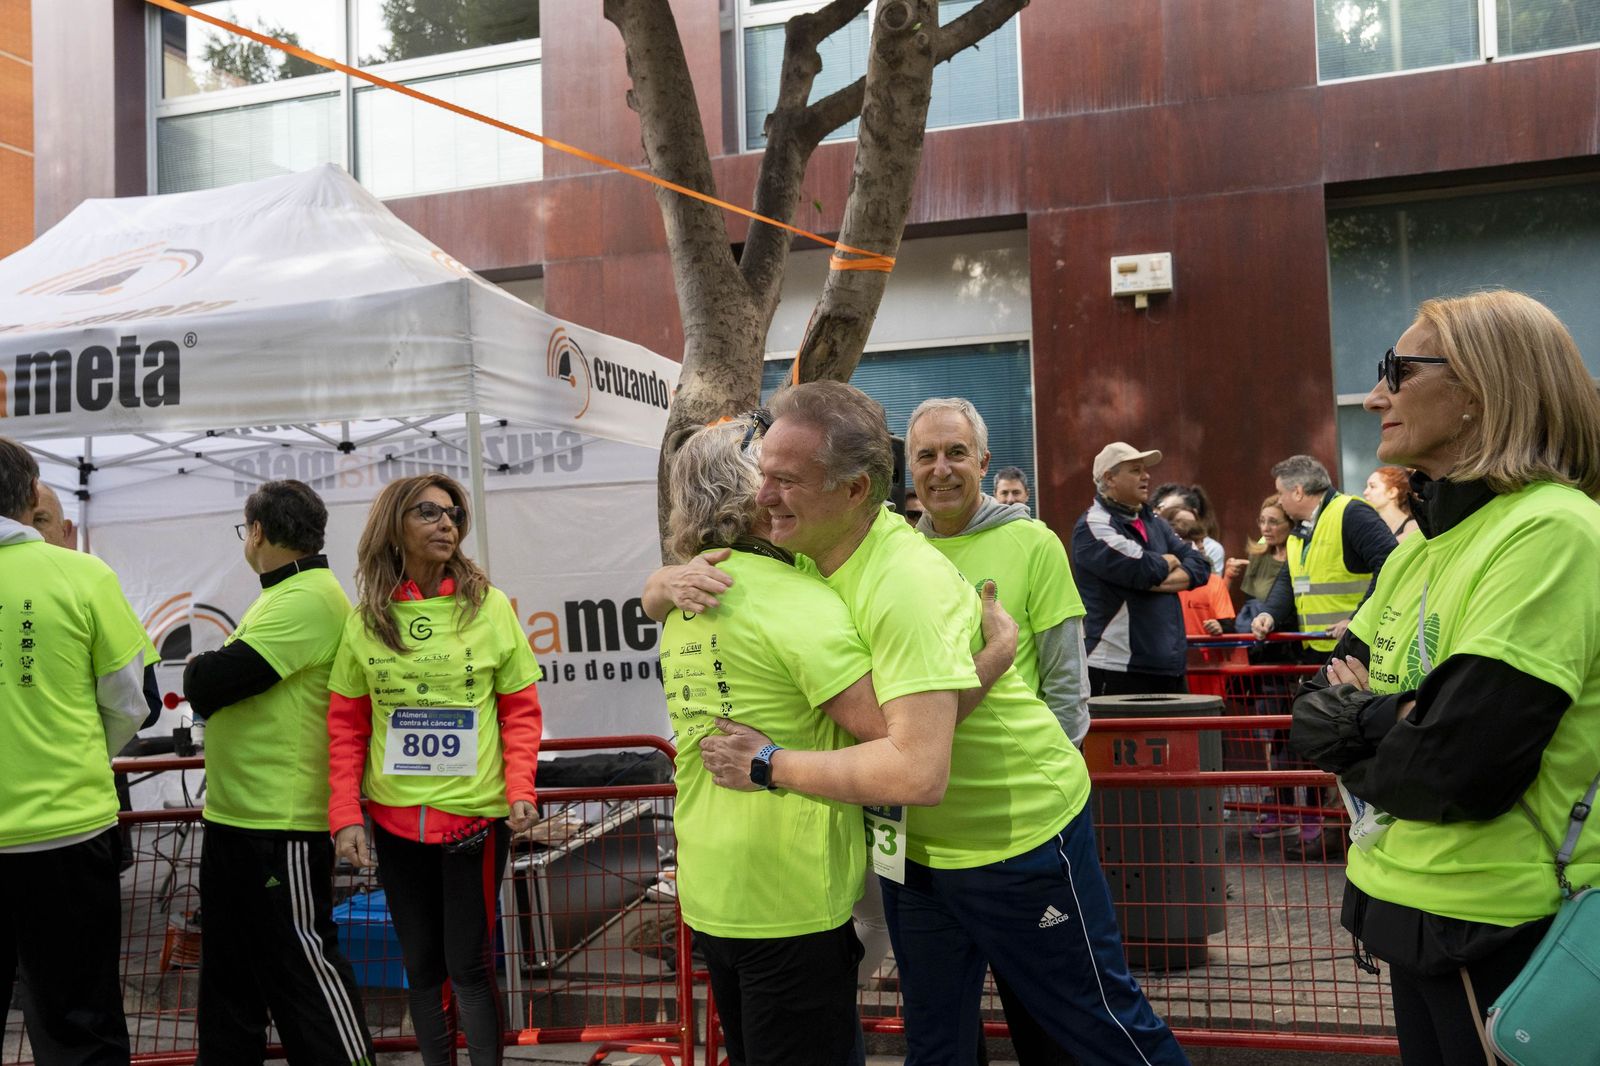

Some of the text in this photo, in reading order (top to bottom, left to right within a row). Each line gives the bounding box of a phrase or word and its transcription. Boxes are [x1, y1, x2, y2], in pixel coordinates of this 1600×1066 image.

[401, 711, 428, 719] Almería
[430, 719, 455, 727] cáncer
[402, 733, 461, 757] 809
[1038, 912, 1069, 929] adidas
